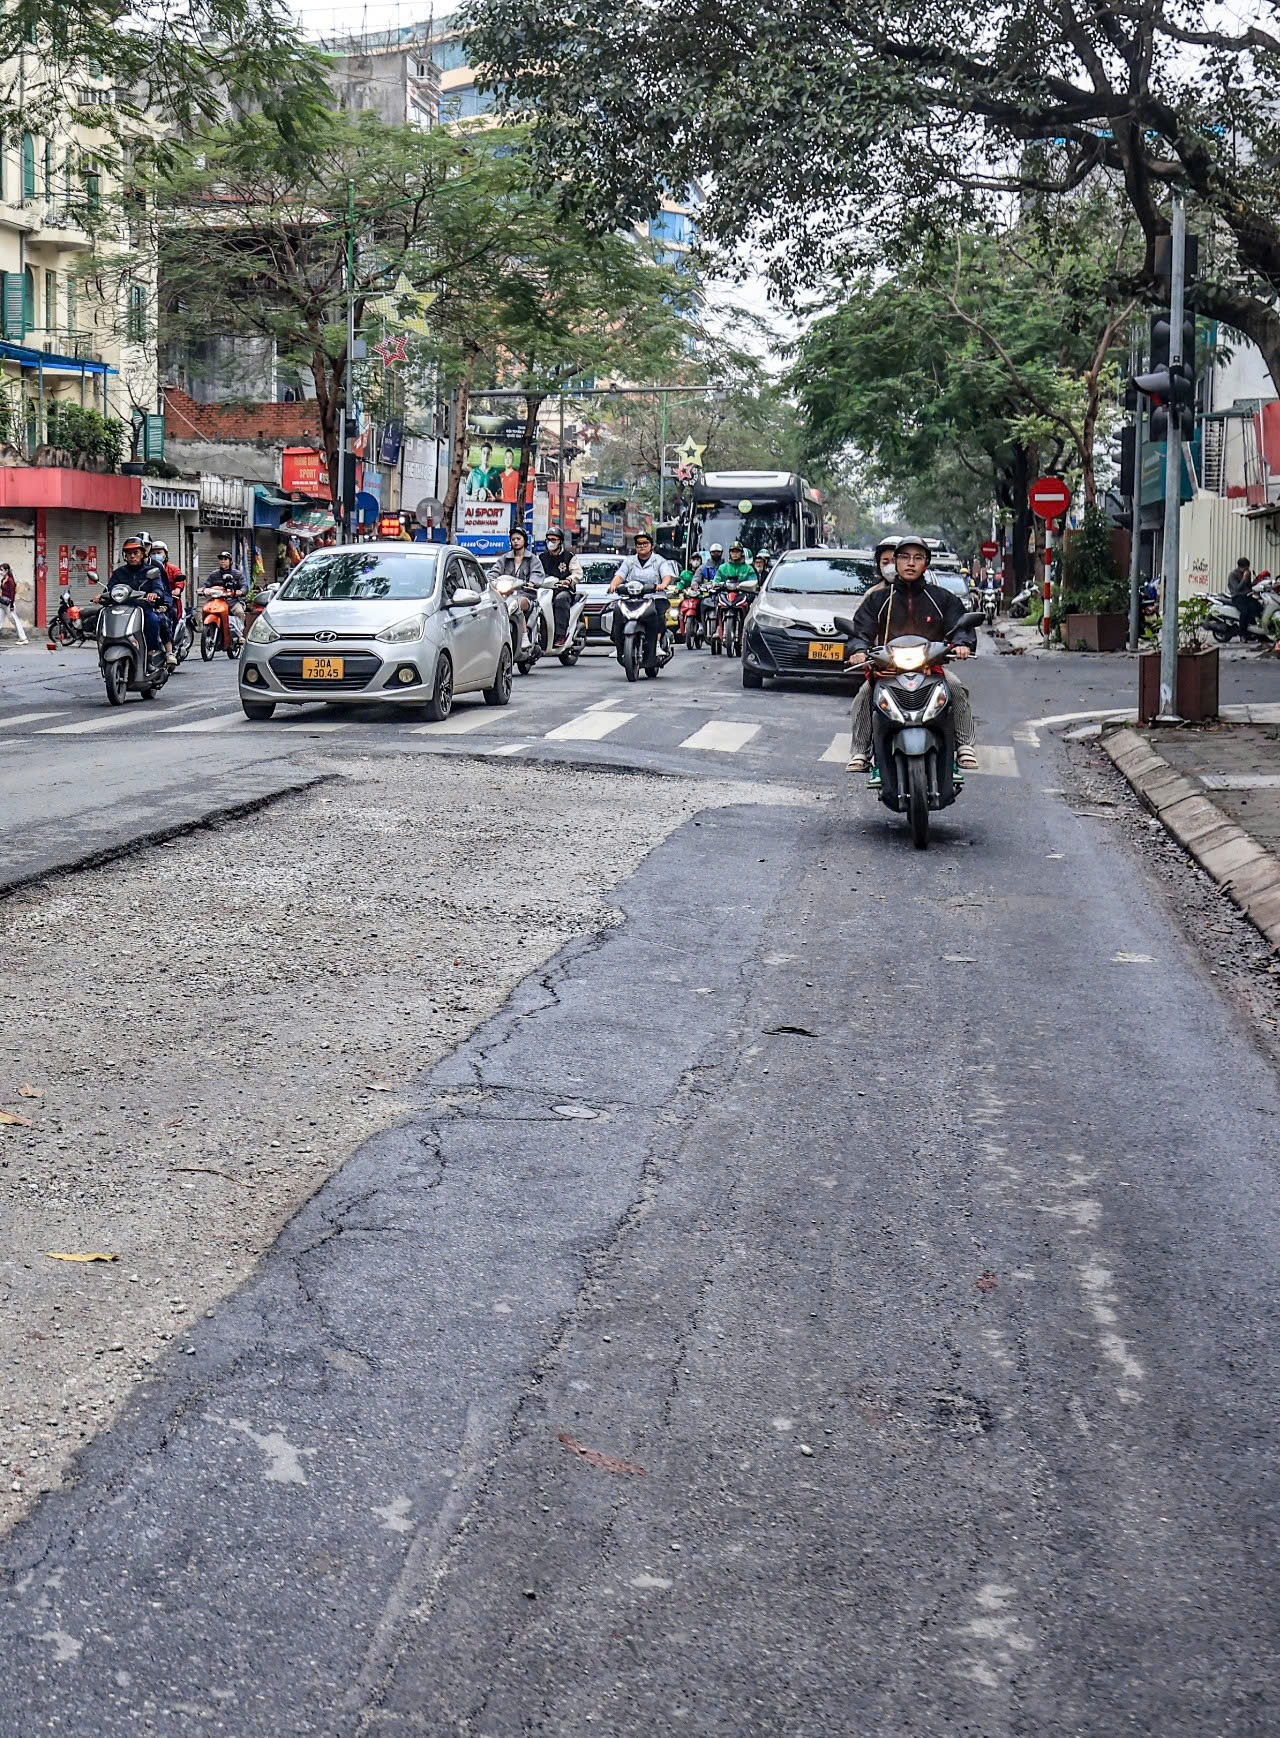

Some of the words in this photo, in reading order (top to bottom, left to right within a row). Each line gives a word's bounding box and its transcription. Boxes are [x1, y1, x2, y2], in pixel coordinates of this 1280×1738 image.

[299, 469, 316, 479] SPORT
[475, 508, 504, 517] SPORT
[314, 659, 331, 668] 30A
[307, 668, 339, 678] 730.45
